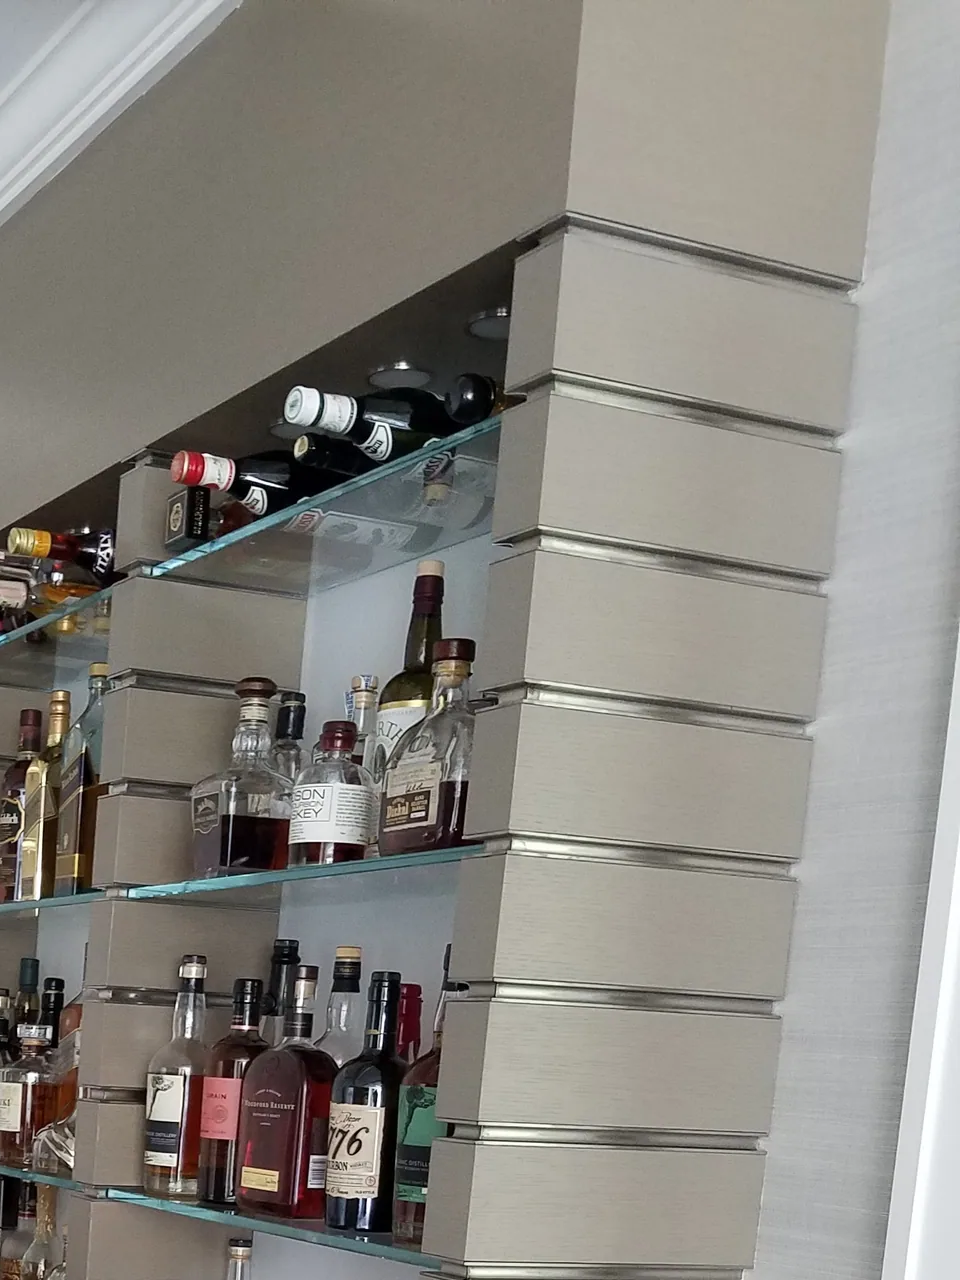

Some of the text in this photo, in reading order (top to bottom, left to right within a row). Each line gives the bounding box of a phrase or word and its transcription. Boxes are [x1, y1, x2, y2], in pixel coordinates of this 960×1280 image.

[96, 533, 113, 574] ITALY
[294, 788, 326, 801] SON
[291, 807, 323, 821] SKEY
[329, 1126, 370, 1160] 776
